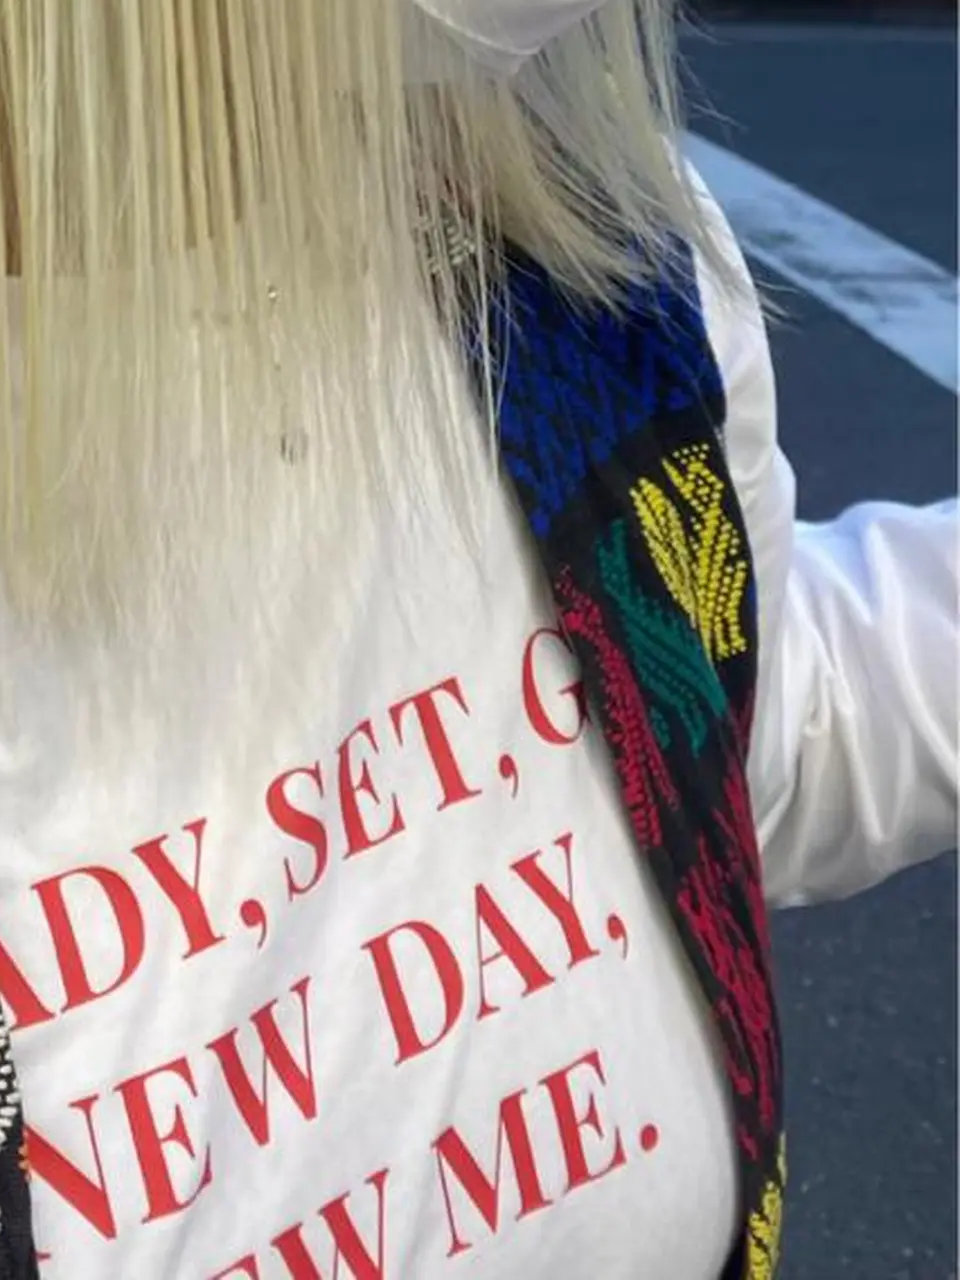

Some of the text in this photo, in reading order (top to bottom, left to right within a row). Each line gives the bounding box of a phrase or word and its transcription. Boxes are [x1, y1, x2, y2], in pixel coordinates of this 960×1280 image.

[265, 675, 520, 904] SET,
[21, 832, 630, 1262] NEW DAY,
[431, 1048, 661, 1258] ME.
